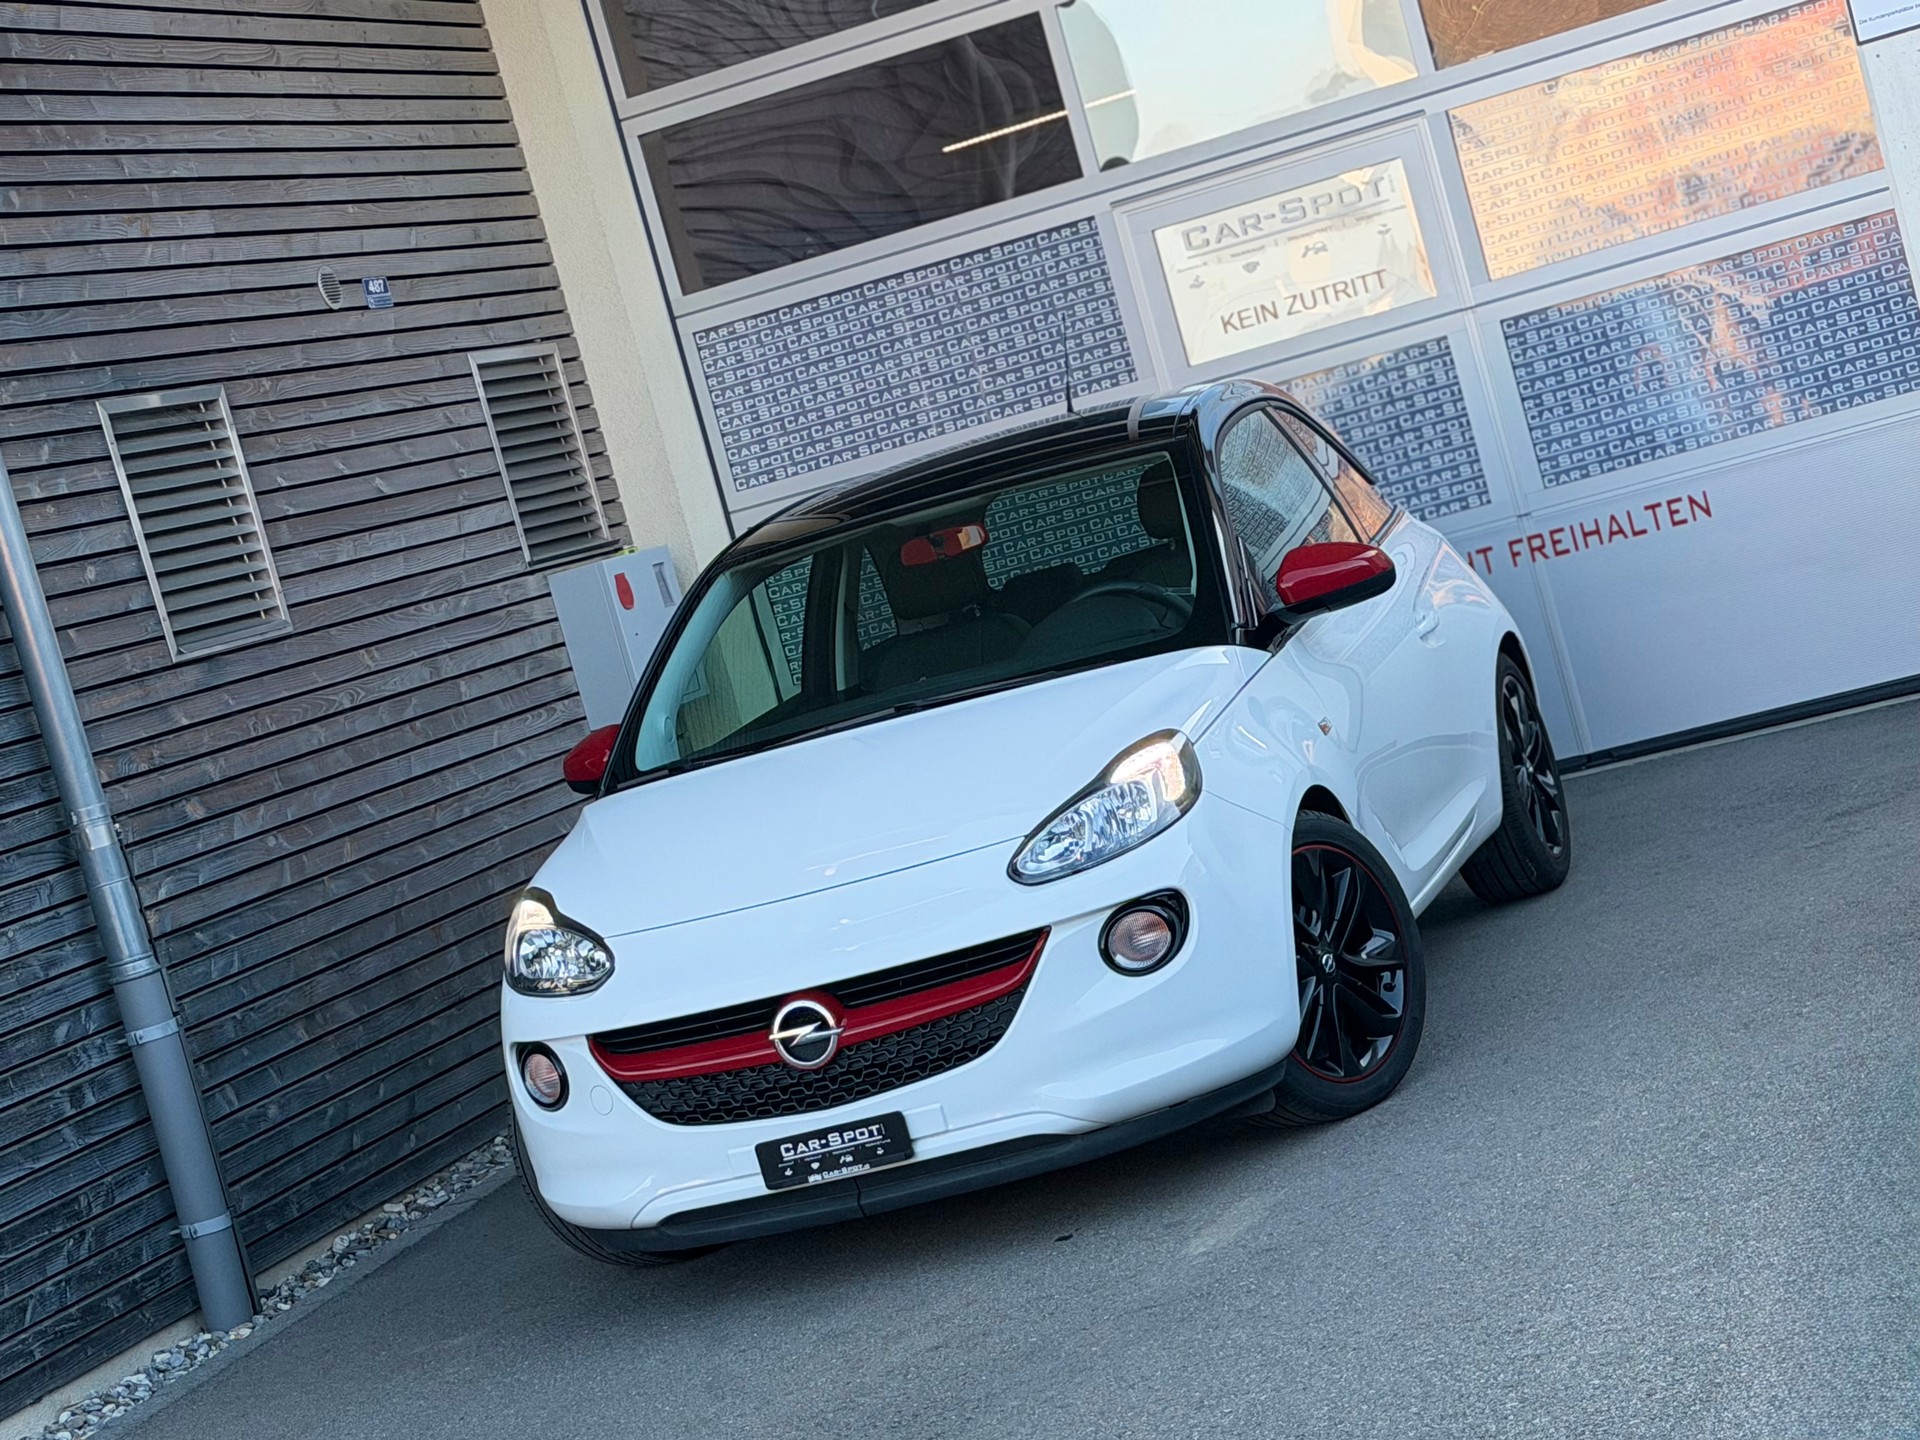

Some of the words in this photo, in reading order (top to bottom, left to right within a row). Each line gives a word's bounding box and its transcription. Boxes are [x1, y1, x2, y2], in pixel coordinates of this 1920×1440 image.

[1181, 176, 1385, 251] CAR-SPOT
[369, 279, 385, 293] 487
[694, 312, 777, 344] CAR-SPOT
[778, 288, 861, 319] CAR-SPOT
[862, 264, 947, 295] CAR-SPOT
[949, 238, 1034, 270] CAR-SPOT
[699, 334, 758, 358] R-SPOT
[759, 310, 842, 341] CAR-SPOT
[844, 285, 928, 317] CAR-SPOT
[930, 260, 1015, 292] CAR-SPOT
[702, 341, 784, 372] CAR-SPOT
[786, 317, 869, 348] CAR-SPOT
[870, 292, 954, 324] CAR-SPOT
[956, 267, 1042, 300] CAR-SPOT
[1220, 300, 1280, 335] KEIN
[1283, 268, 1387, 316] ZUTRITT
[707, 362, 766, 387] R-SPOT
[767, 338, 850, 370] CAR-SPOT
[852, 314, 935, 346] CAR-SPOT
[937, 289, 1022, 321] CAR-SPOT
[710, 371, 792, 402] CAR-SPOT
[794, 348, 877, 378] CAR-SPOT
[878, 323, 962, 354] CAR-SPOT
[965, 298, 1050, 330] CAR-SPOT
[715, 393, 774, 417] R-SPOT
[775, 369, 858, 400] CAR-SPOT
[860, 345, 944, 376] CAR-SPOT
[945, 320, 1031, 352] CAR-SPOT
[1507, 321, 1573, 349] R-SPOT
[1515, 352, 1581, 378] R-SPOT
[718, 400, 800, 430] CAR-SPOT
[801, 376, 884, 407] CAR-SPOT
[886, 352, 970, 383] CAR-SPOT
[972, 327, 1058, 359] CAR-SPOT
[723, 421, 781, 445] R-SPOT
[783, 397, 866, 428] CAR-SPOT
[867, 373, 951, 404] CAR-SPOT
[953, 349, 1038, 380] CAR-SPOT
[726, 430, 808, 460] CAR-SPOT
[809, 407, 893, 437] CAR-SPOT
[894, 383, 978, 414] CAR-SPOT
[980, 358, 1066, 389] CAR-SPOT
[1315, 388, 1388, 416] AR-SPOT
[1523, 383, 1589, 410] R-SPOT
[1835, 378, 1920, 409] CAR-SPO
[731, 451, 789, 475] R-SPOT
[791, 428, 874, 458] CAR-SPOT
[875, 404, 959, 435] CAR-SPOT
[961, 380, 1046, 411] CAR-SPOT
[734, 460, 816, 490] CAR-SPOT
[817, 437, 901, 467] CAR-SPOT
[902, 413, 986, 444] CAR-SPOT
[1531, 413, 1597, 440] R-SPOT
[1539, 446, 1606, 472] R-SPOT
[1508, 490, 1713, 568] FREIHALTEN
[780, 1124, 880, 1157] CAR-SPOT
